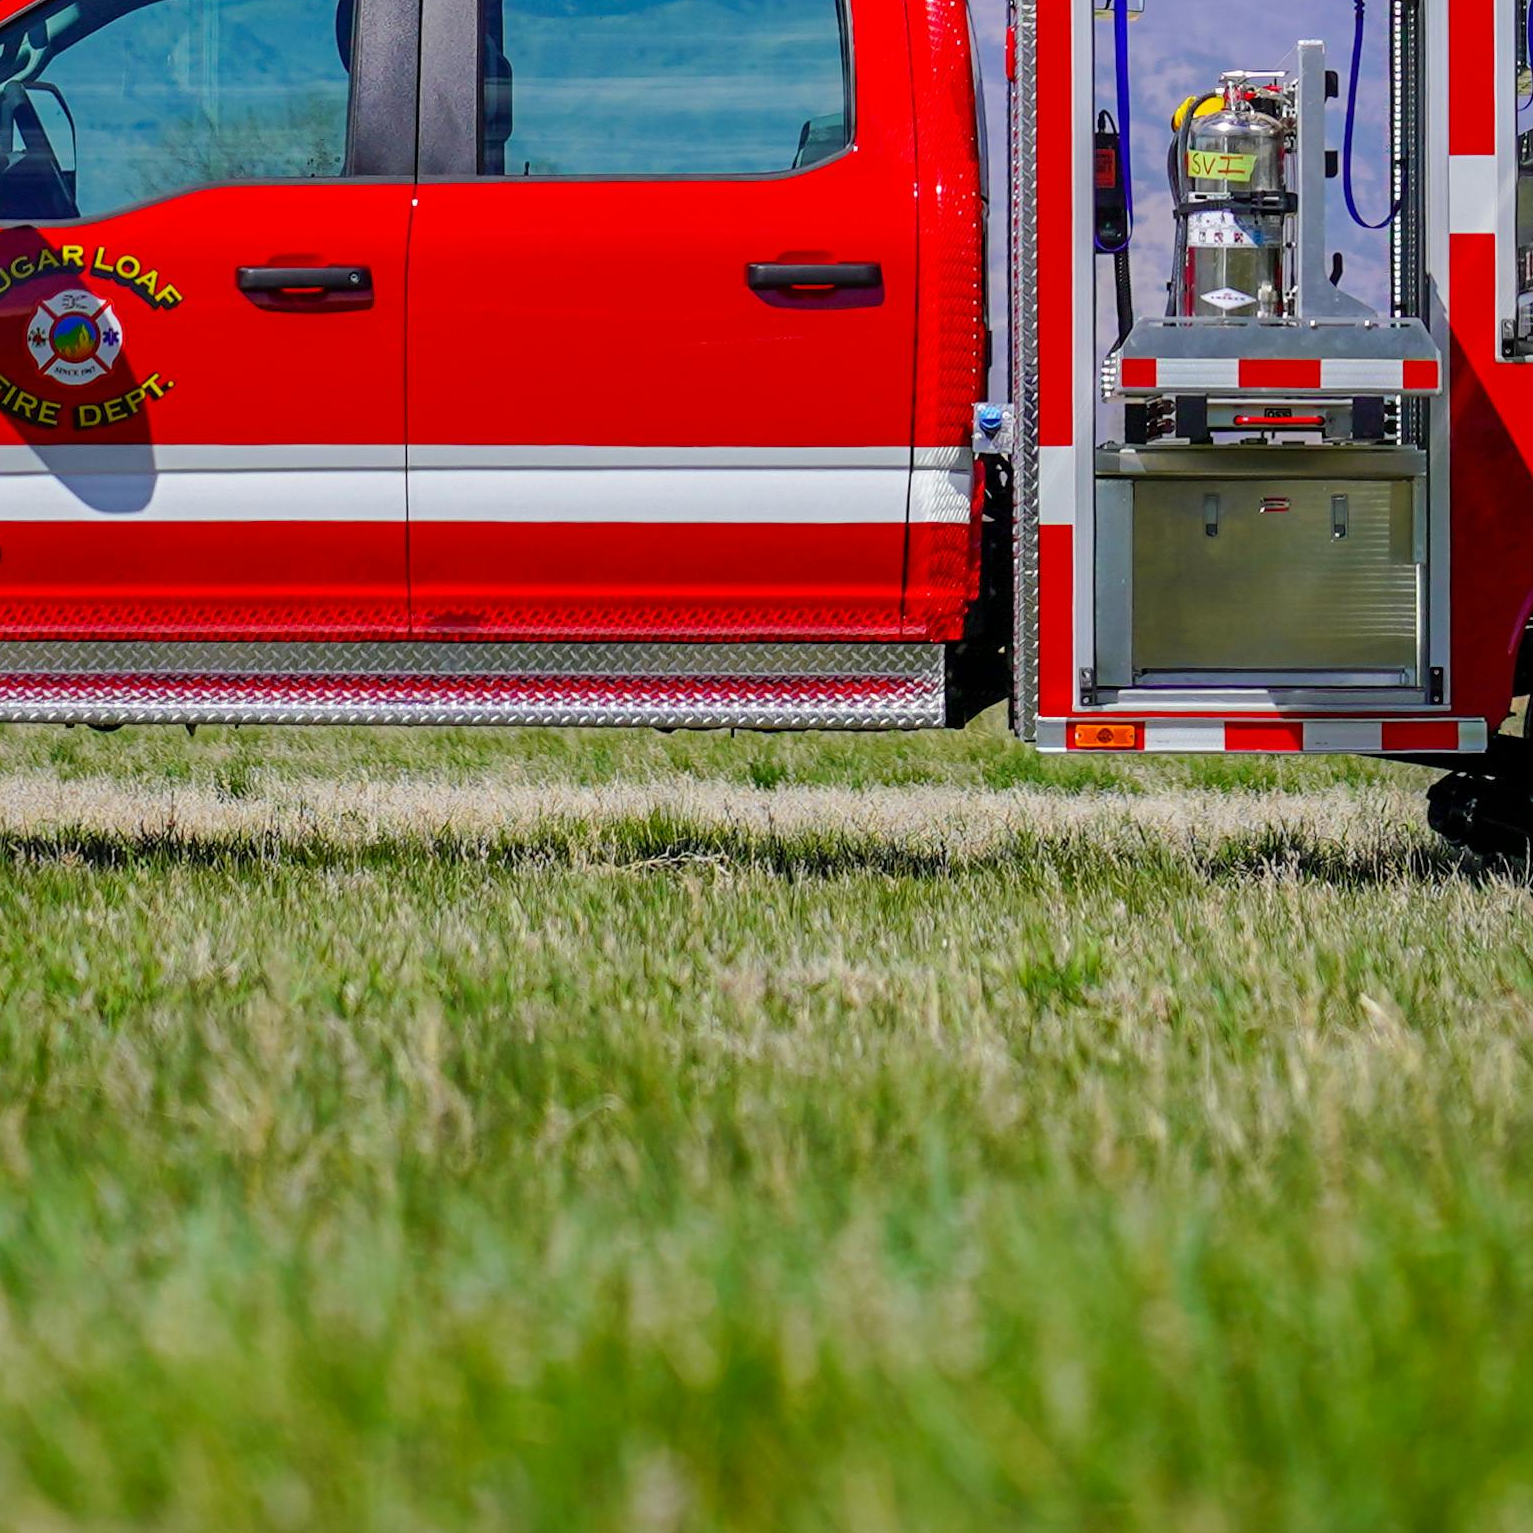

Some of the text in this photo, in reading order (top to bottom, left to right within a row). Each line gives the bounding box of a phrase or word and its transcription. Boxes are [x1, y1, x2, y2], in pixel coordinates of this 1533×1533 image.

[1191, 152, 1246, 176] SVI
[93, 246, 183, 306] LOAF
[77, 372, 175, 428] DEPT.
